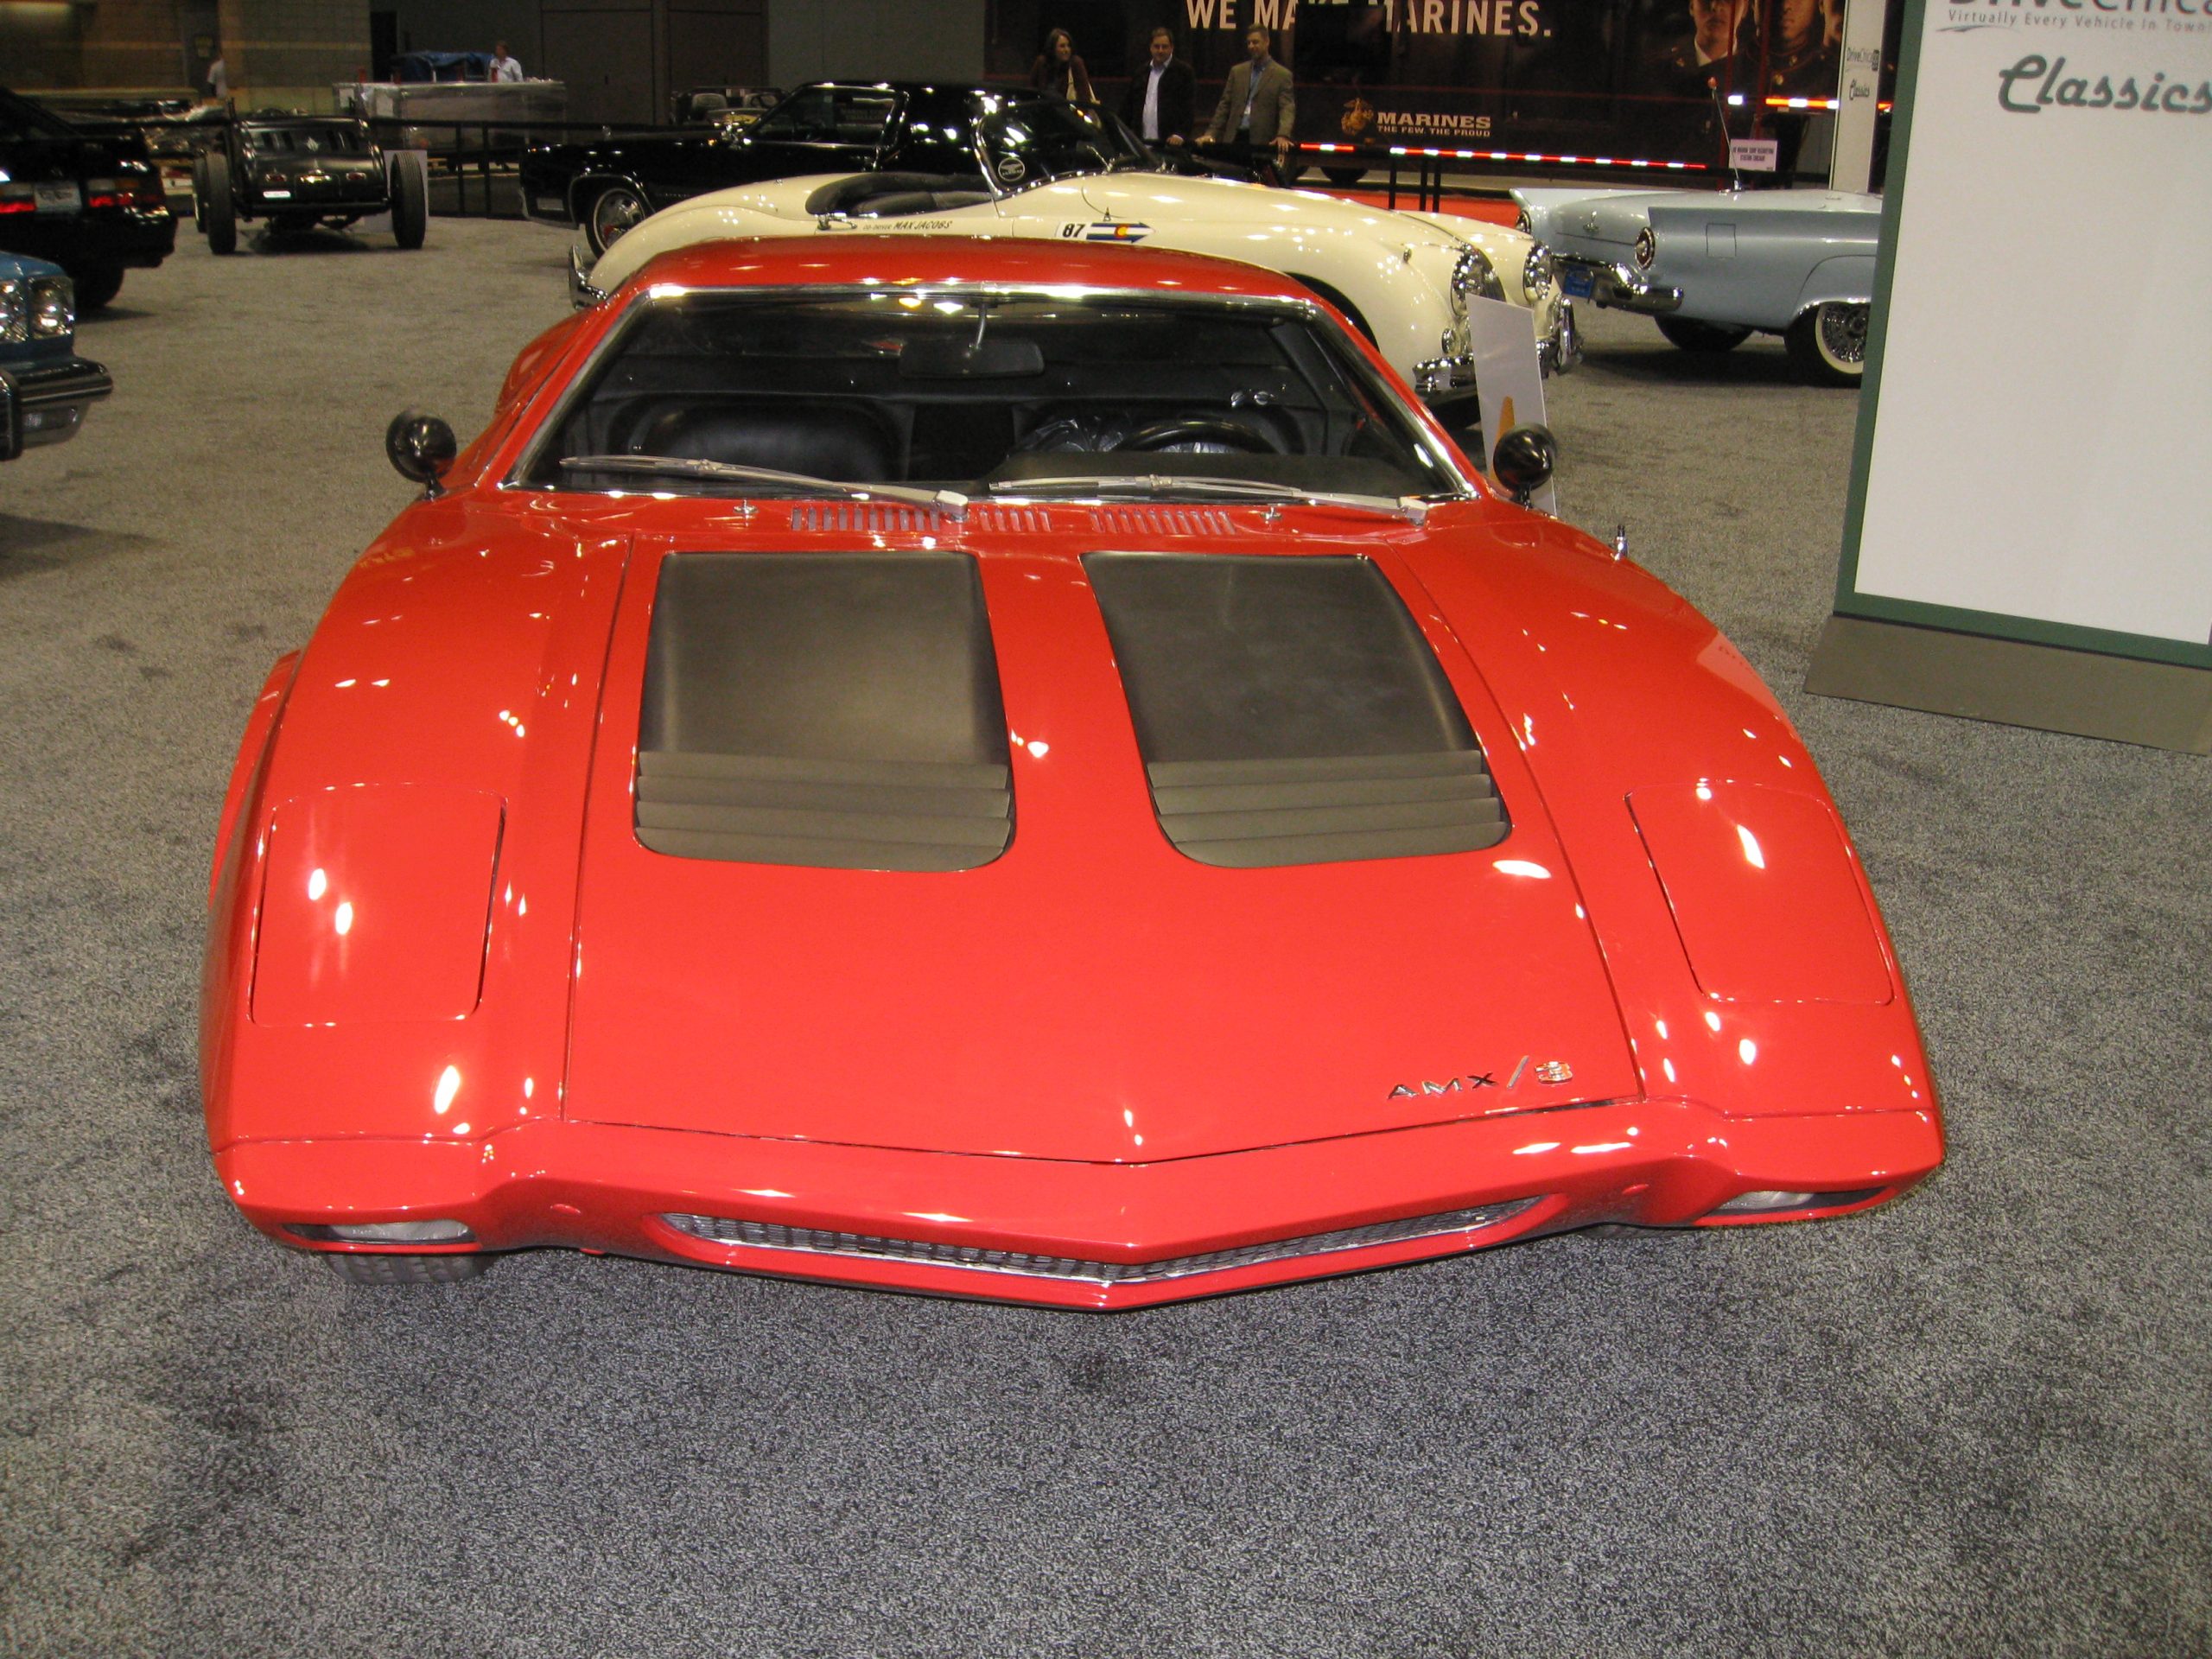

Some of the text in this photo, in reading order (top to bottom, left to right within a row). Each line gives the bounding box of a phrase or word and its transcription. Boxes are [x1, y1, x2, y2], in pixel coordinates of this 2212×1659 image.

[1186, 0, 1236, 29] WE
[1948, 10, 2017, 27] Virtually
[2024, 14, 2068, 29] Every
[2075, 16, 2134, 30] Vehicle
[1998, 54, 2212, 114] Classics
[1377, 112, 1491, 129] MARINES
[1377, 124, 1398, 133] THE
[1062, 224, 1086, 238] 87
